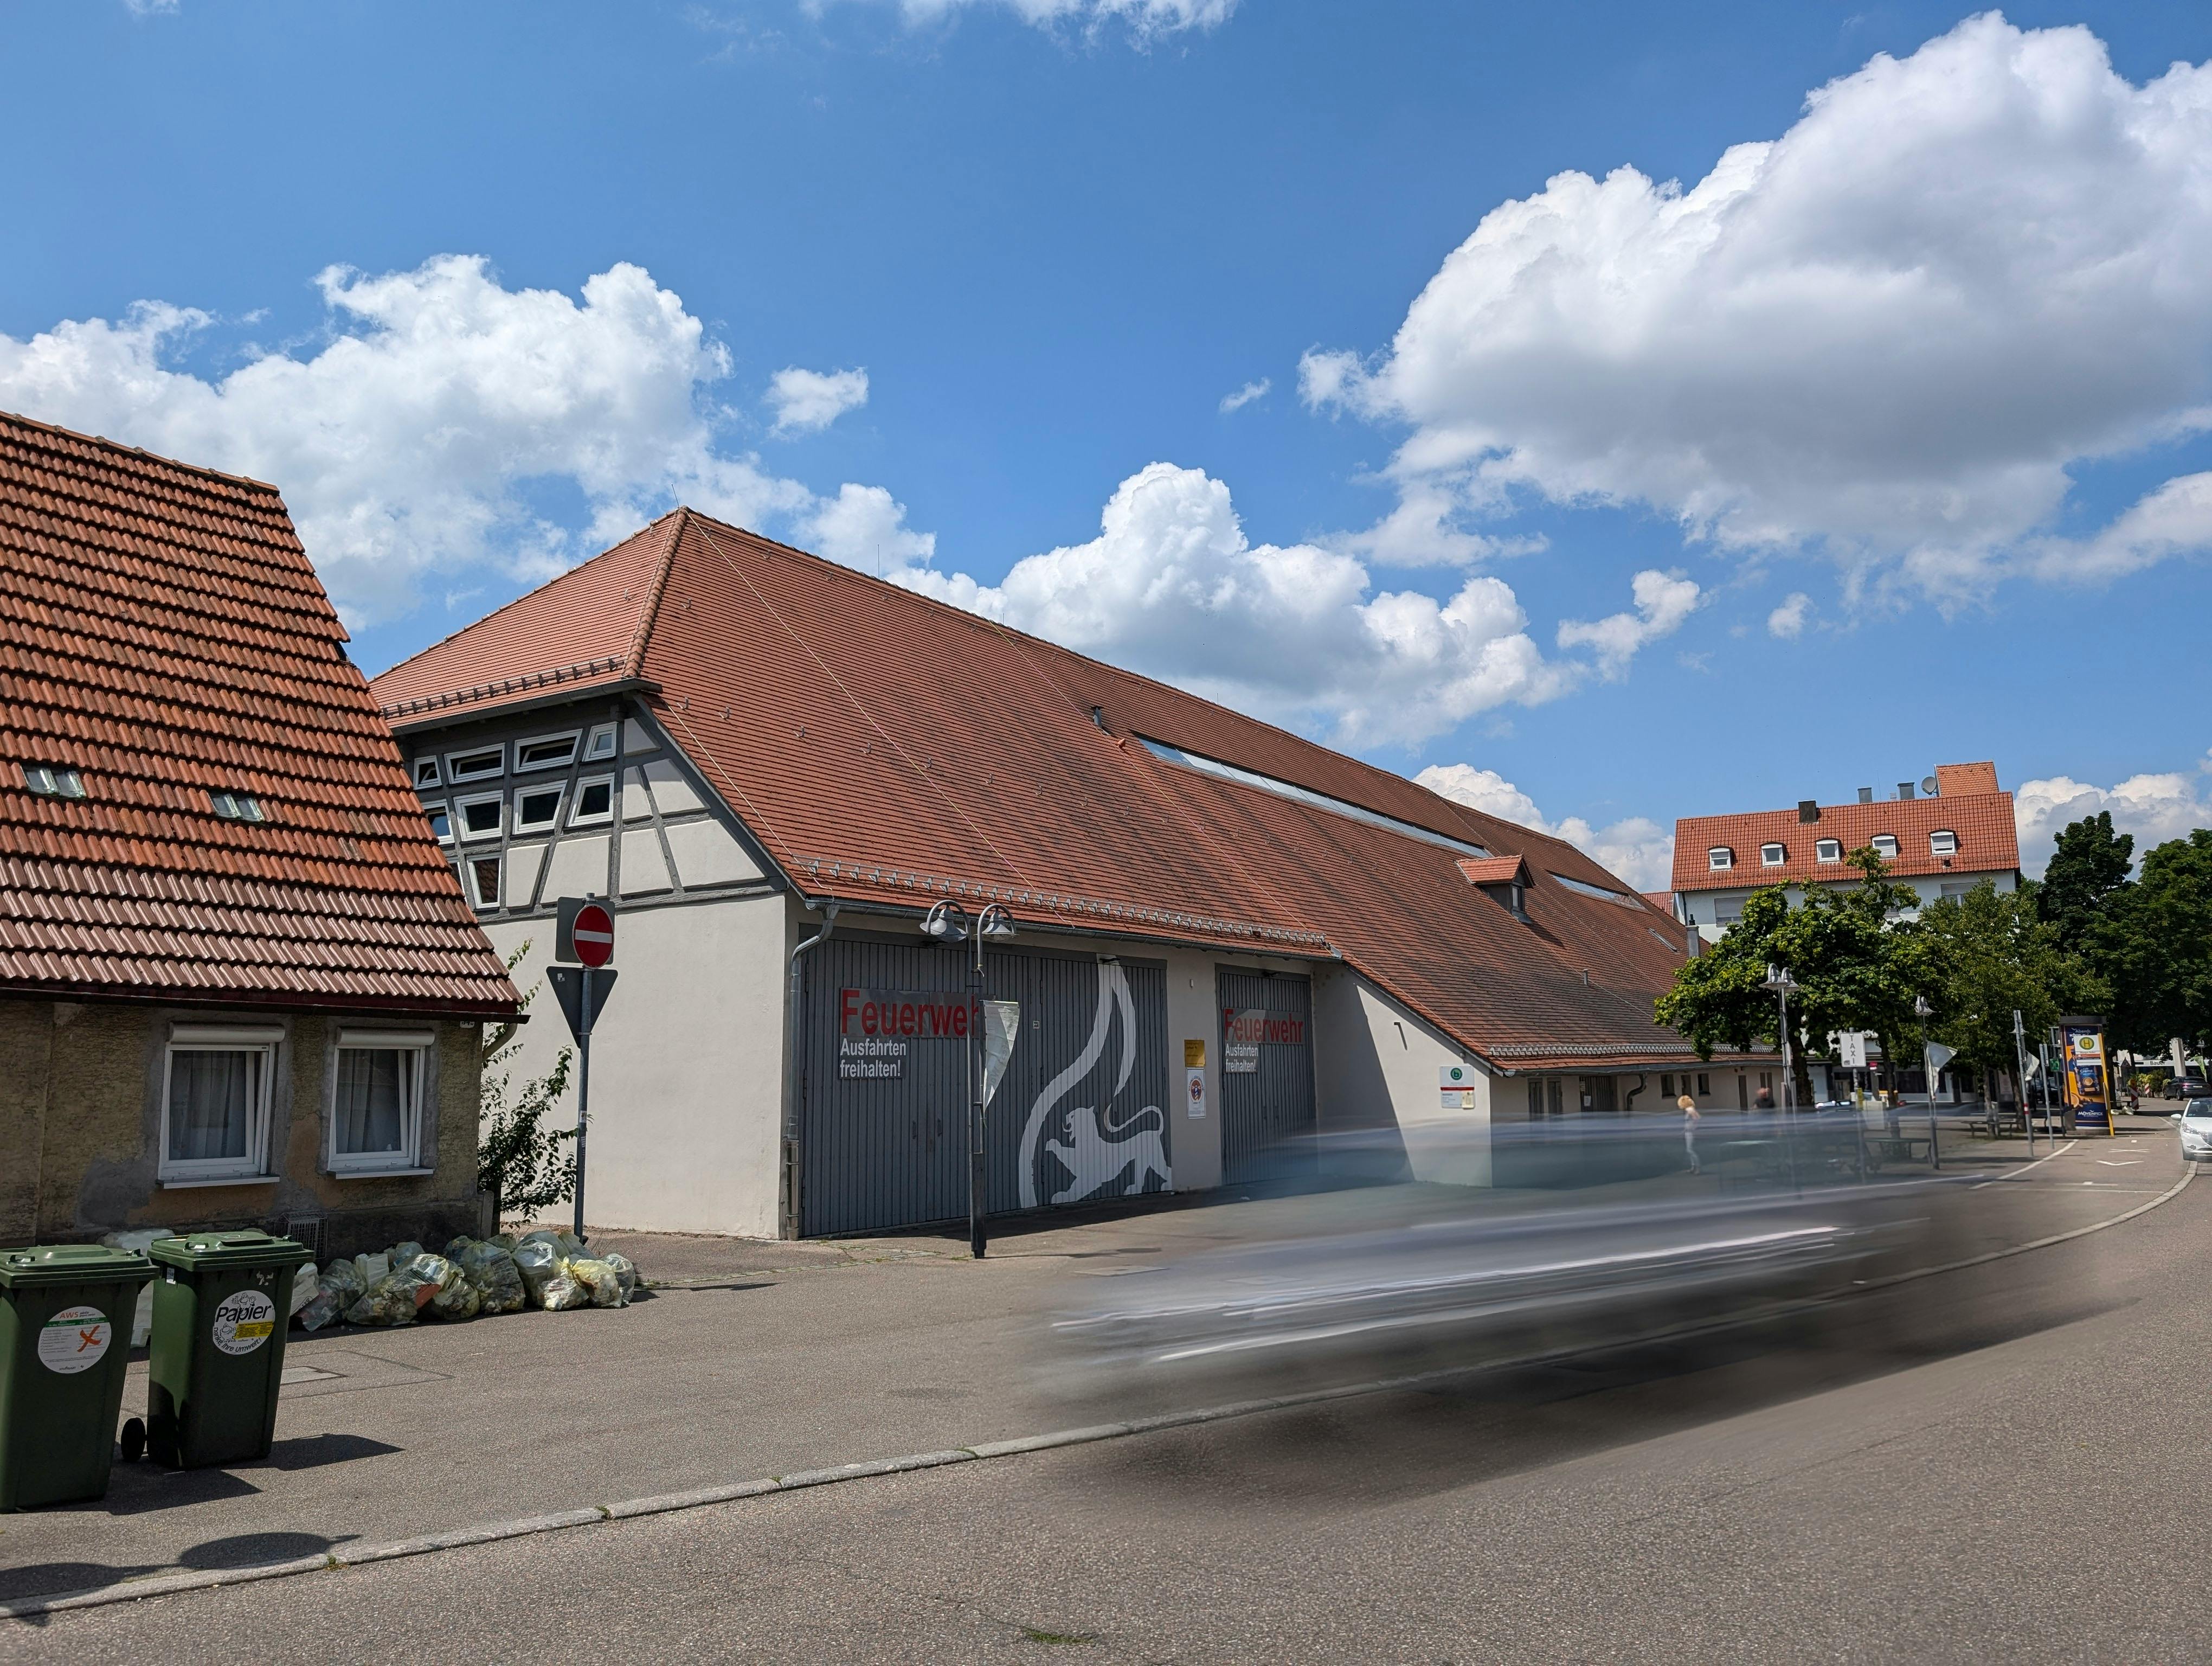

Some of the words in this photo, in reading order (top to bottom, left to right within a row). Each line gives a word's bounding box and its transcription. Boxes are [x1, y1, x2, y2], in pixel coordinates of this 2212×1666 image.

[1225, 1009, 1303, 1043] Feuerwehr
[840, 1038, 906, 1056] Ausfahrten
[1225, 1043, 1258, 1057] Ausfahrten
[2084, 1040, 2091, 1048] H
[840, 1060, 901, 1078] freihalten!
[1225, 1059, 1256, 1072] freihalten!
[60, 1311, 79, 1319] AWS
[216, 1305, 272, 1324] Papier
